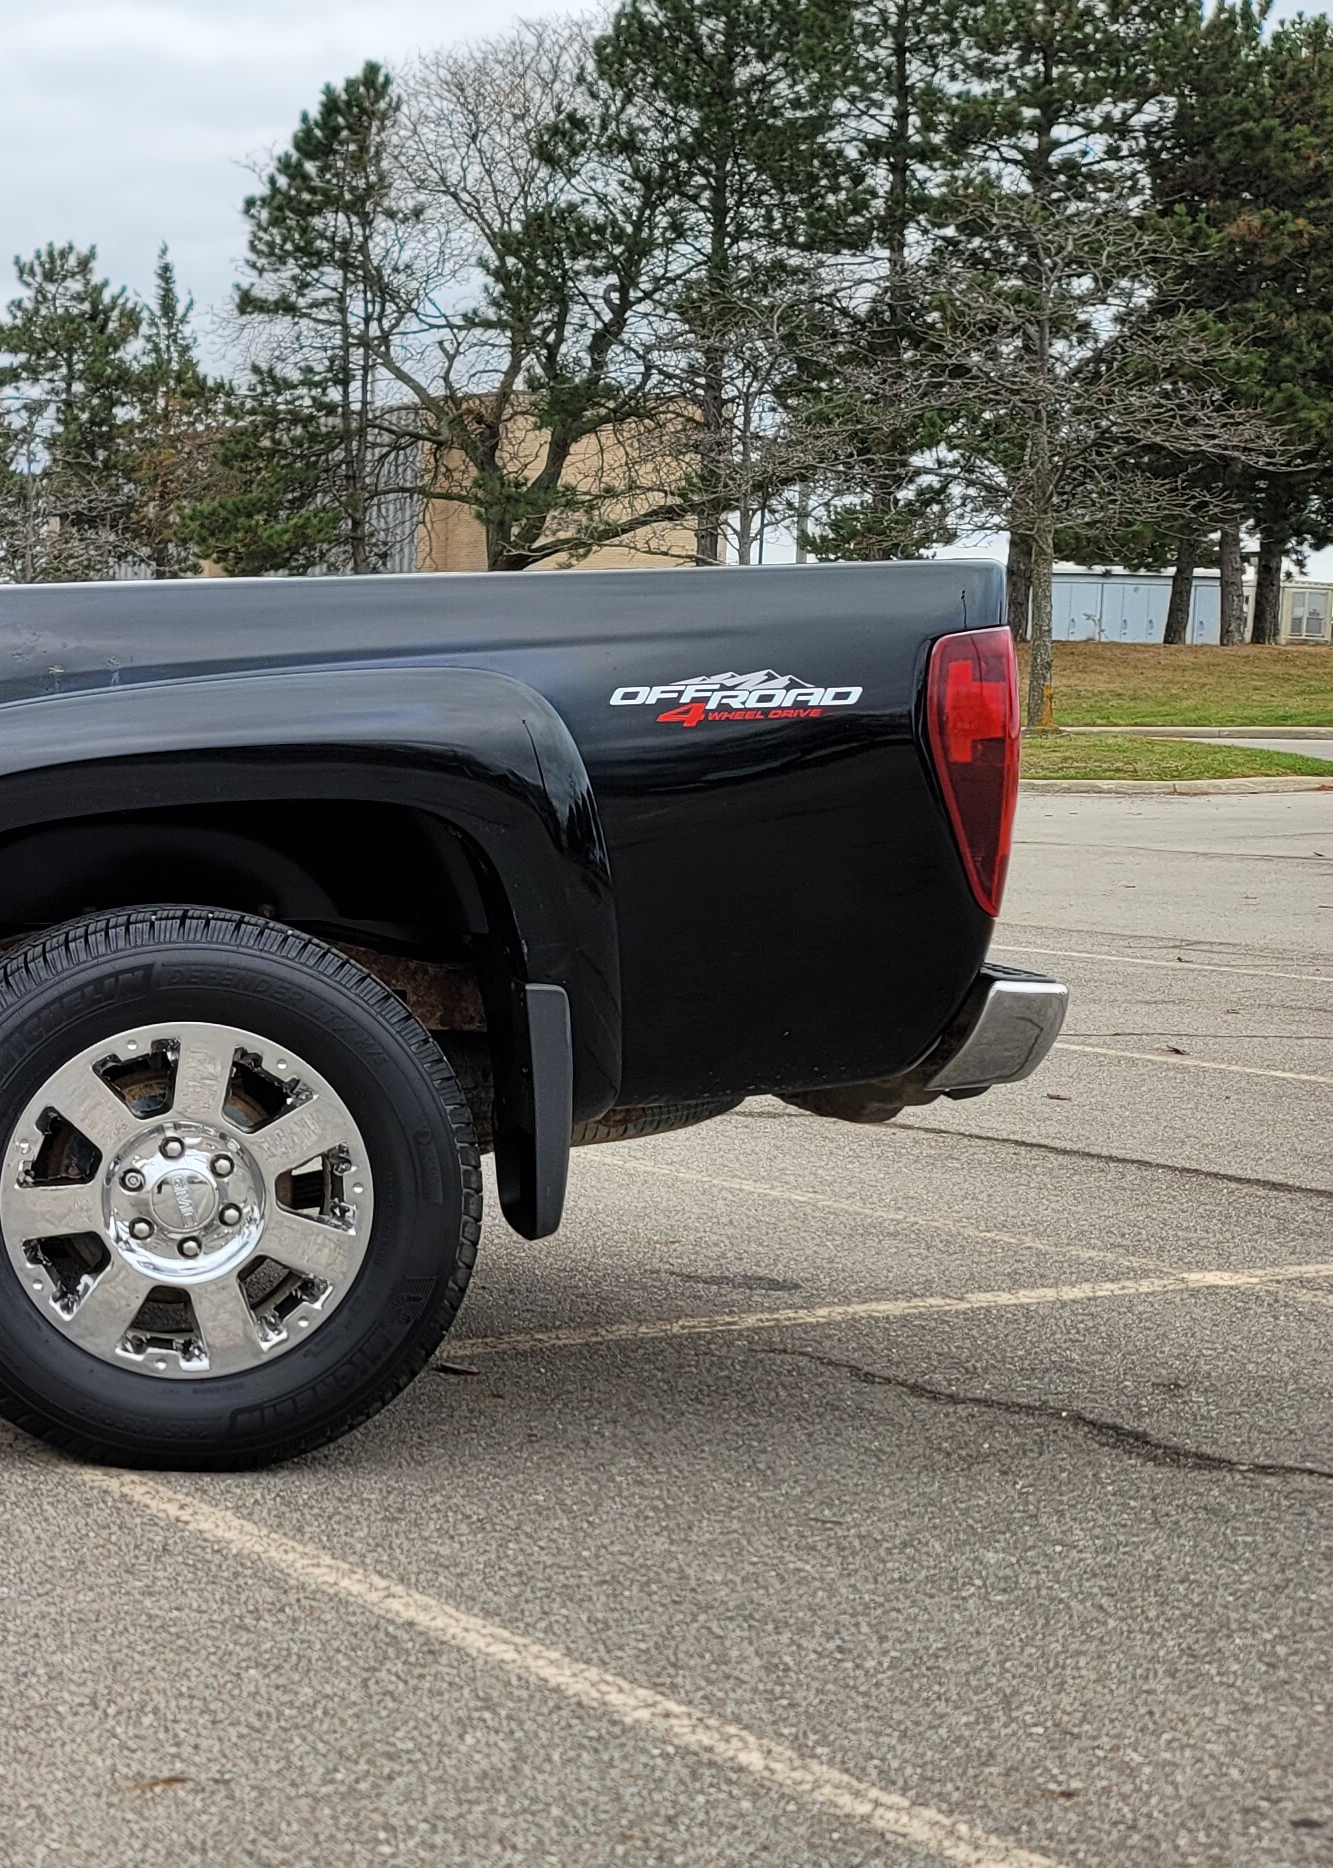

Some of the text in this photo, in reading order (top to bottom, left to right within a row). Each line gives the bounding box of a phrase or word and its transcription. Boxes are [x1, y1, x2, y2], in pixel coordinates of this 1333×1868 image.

[656, 703, 822, 727] 4 WHEEL DRIVE
[170, 969, 304, 1004] DEFENDER
[171, 1175, 199, 1229] GMC
